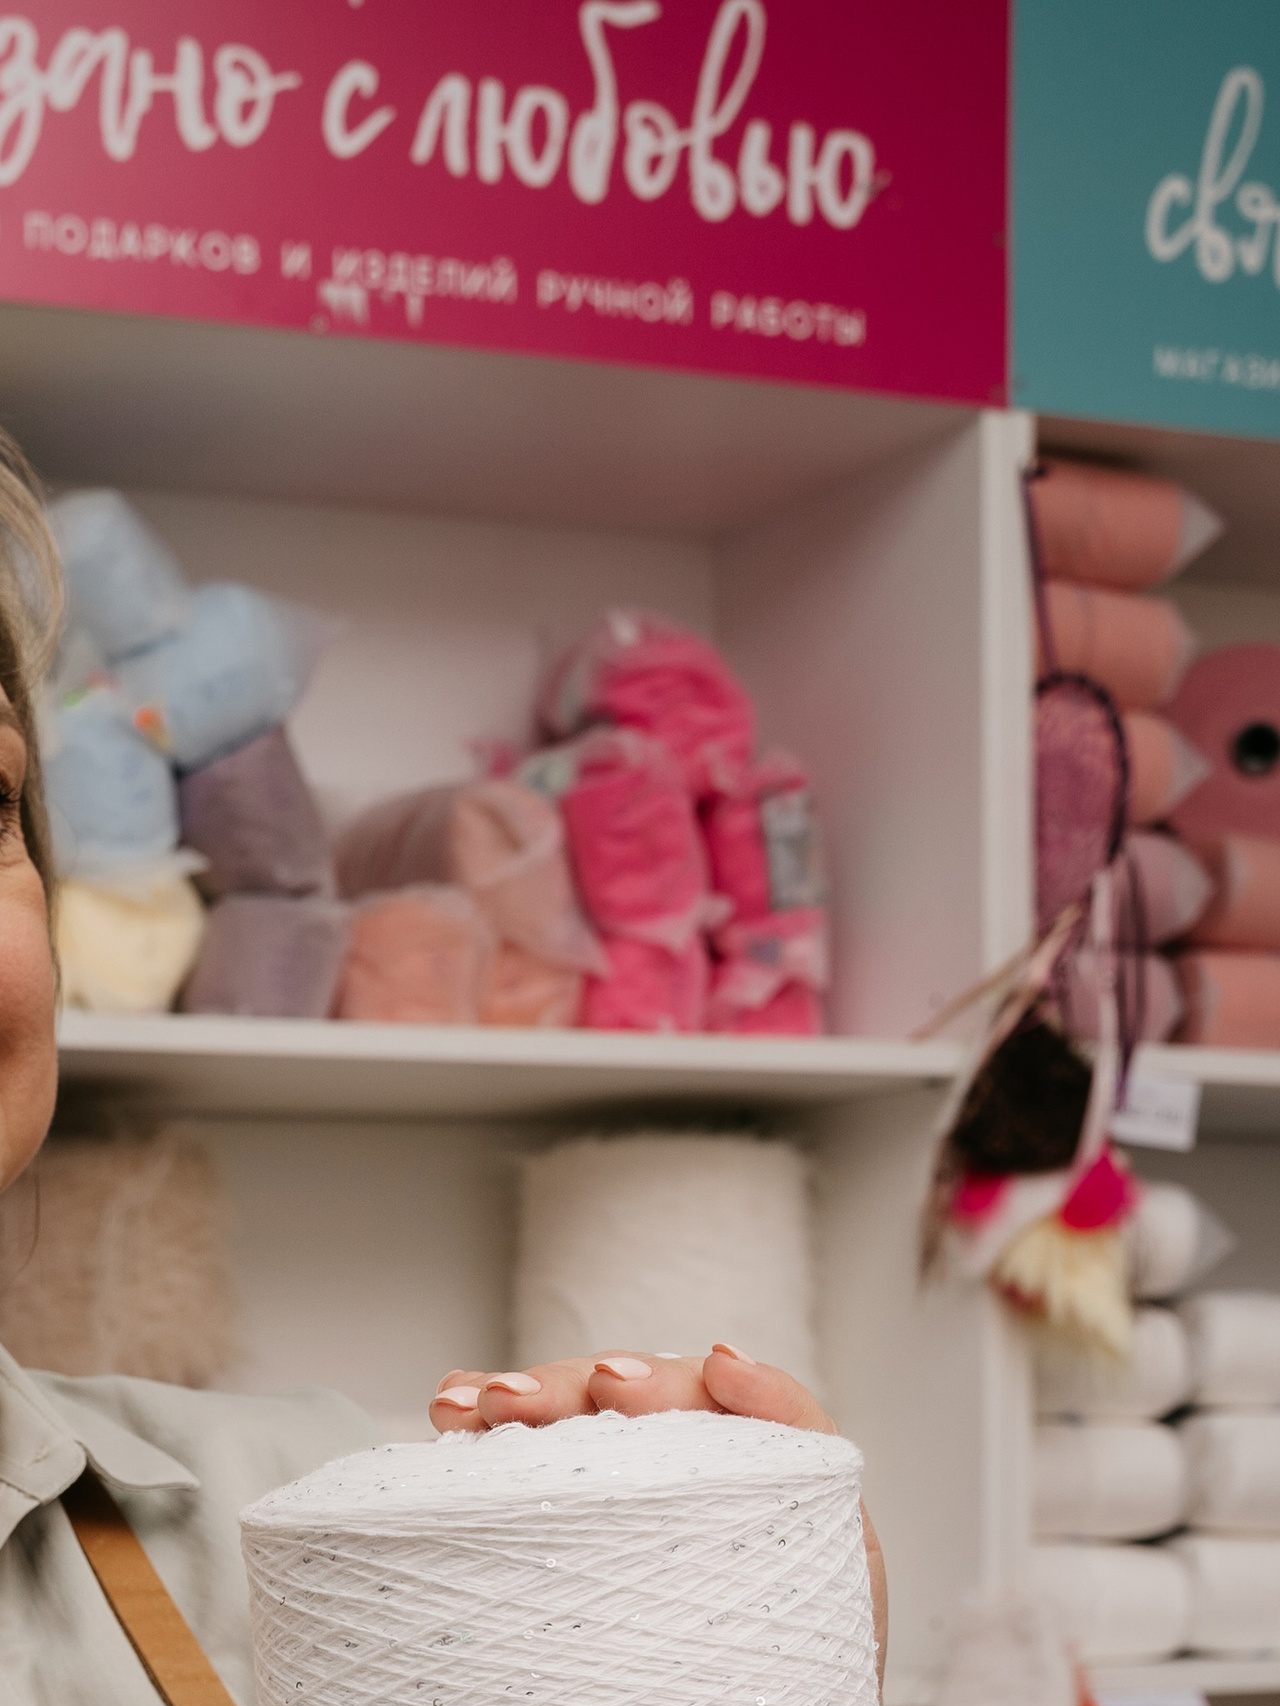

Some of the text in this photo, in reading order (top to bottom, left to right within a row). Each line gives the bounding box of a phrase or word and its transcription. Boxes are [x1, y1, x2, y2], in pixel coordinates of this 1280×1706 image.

[324, 60, 396, 158] с
[410, 0, 878, 230] любовью
[23, 210, 260, 275] ПОДАРКОВ
[281, 241, 311, 280] И
[332, 247, 517, 303] ИЗДЕЛИЙ
[537, 269, 693, 325] РУЧНОЙ
[711, 290, 866, 346] РАБОТЫ
